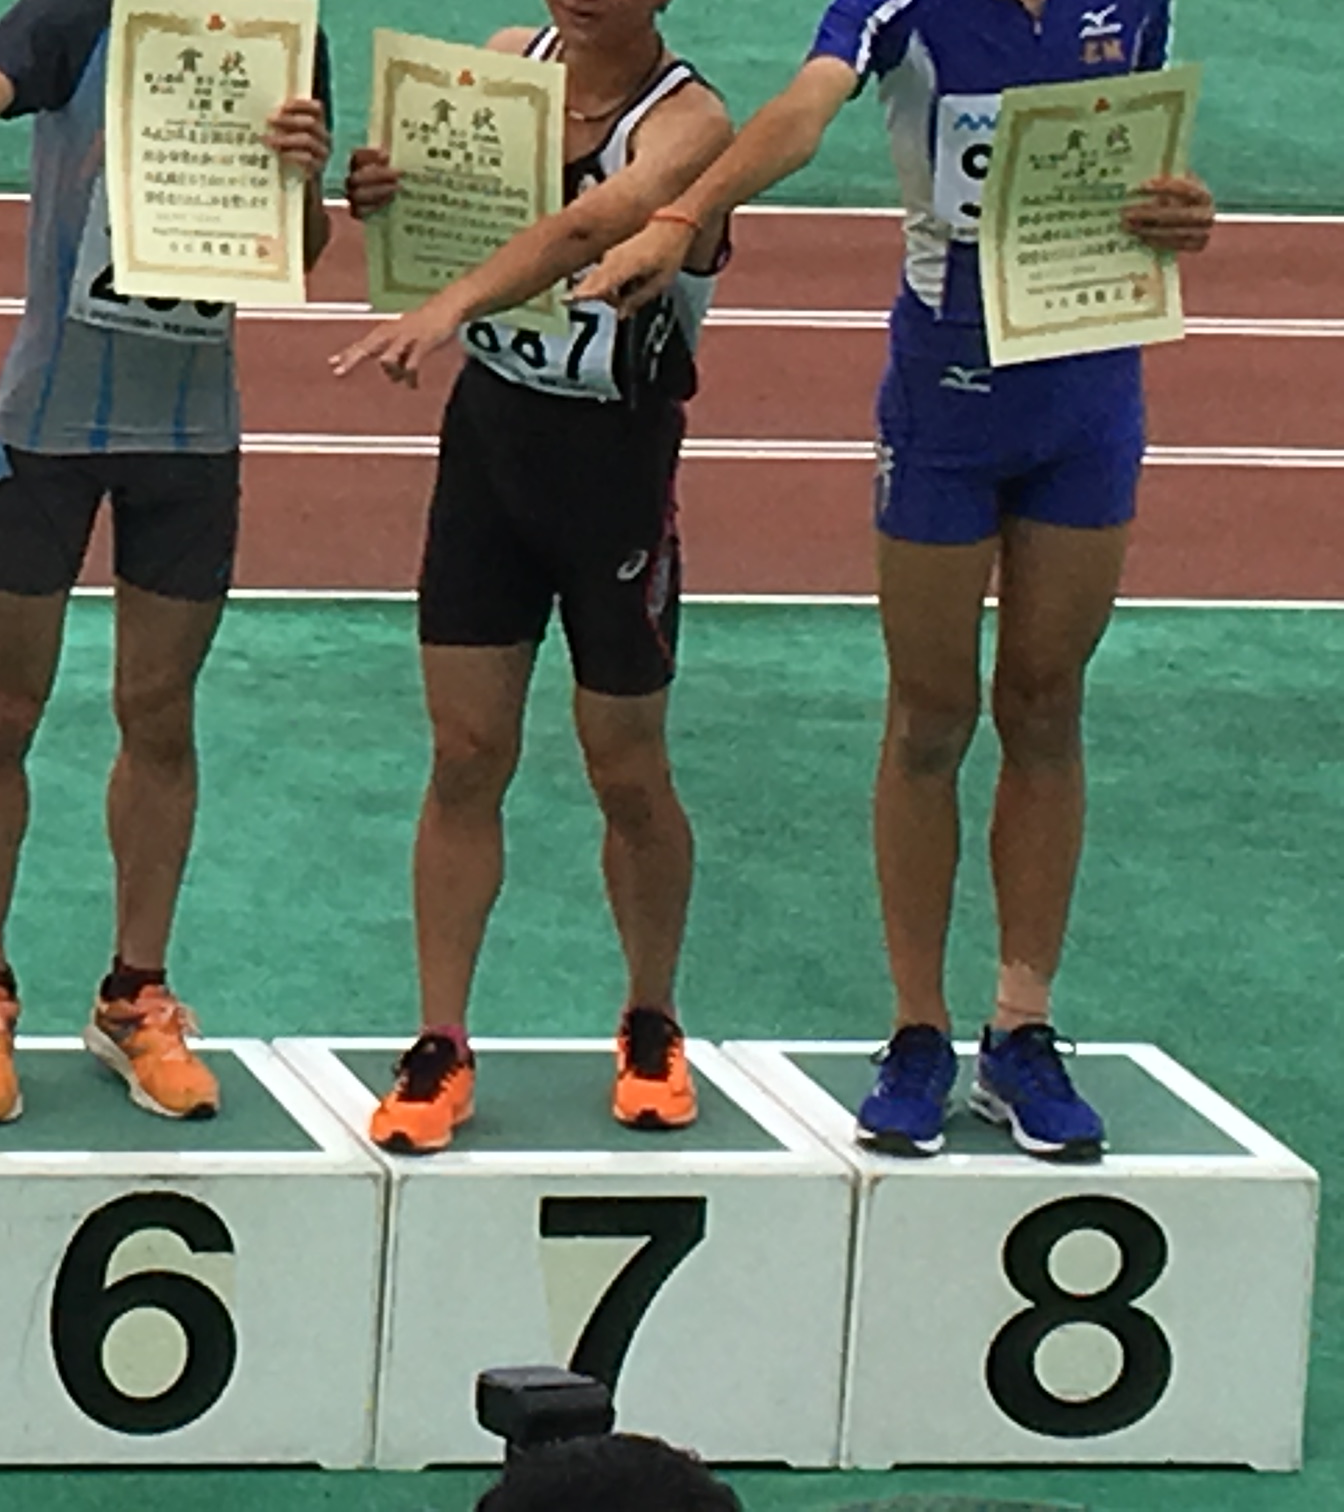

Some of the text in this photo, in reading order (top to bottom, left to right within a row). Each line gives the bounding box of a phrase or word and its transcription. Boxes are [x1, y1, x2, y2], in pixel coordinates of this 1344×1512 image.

[51, 1191, 236, 1435] 6
[540, 1197, 707, 1432] 7
[986, 1195, 1171, 1438] 8
